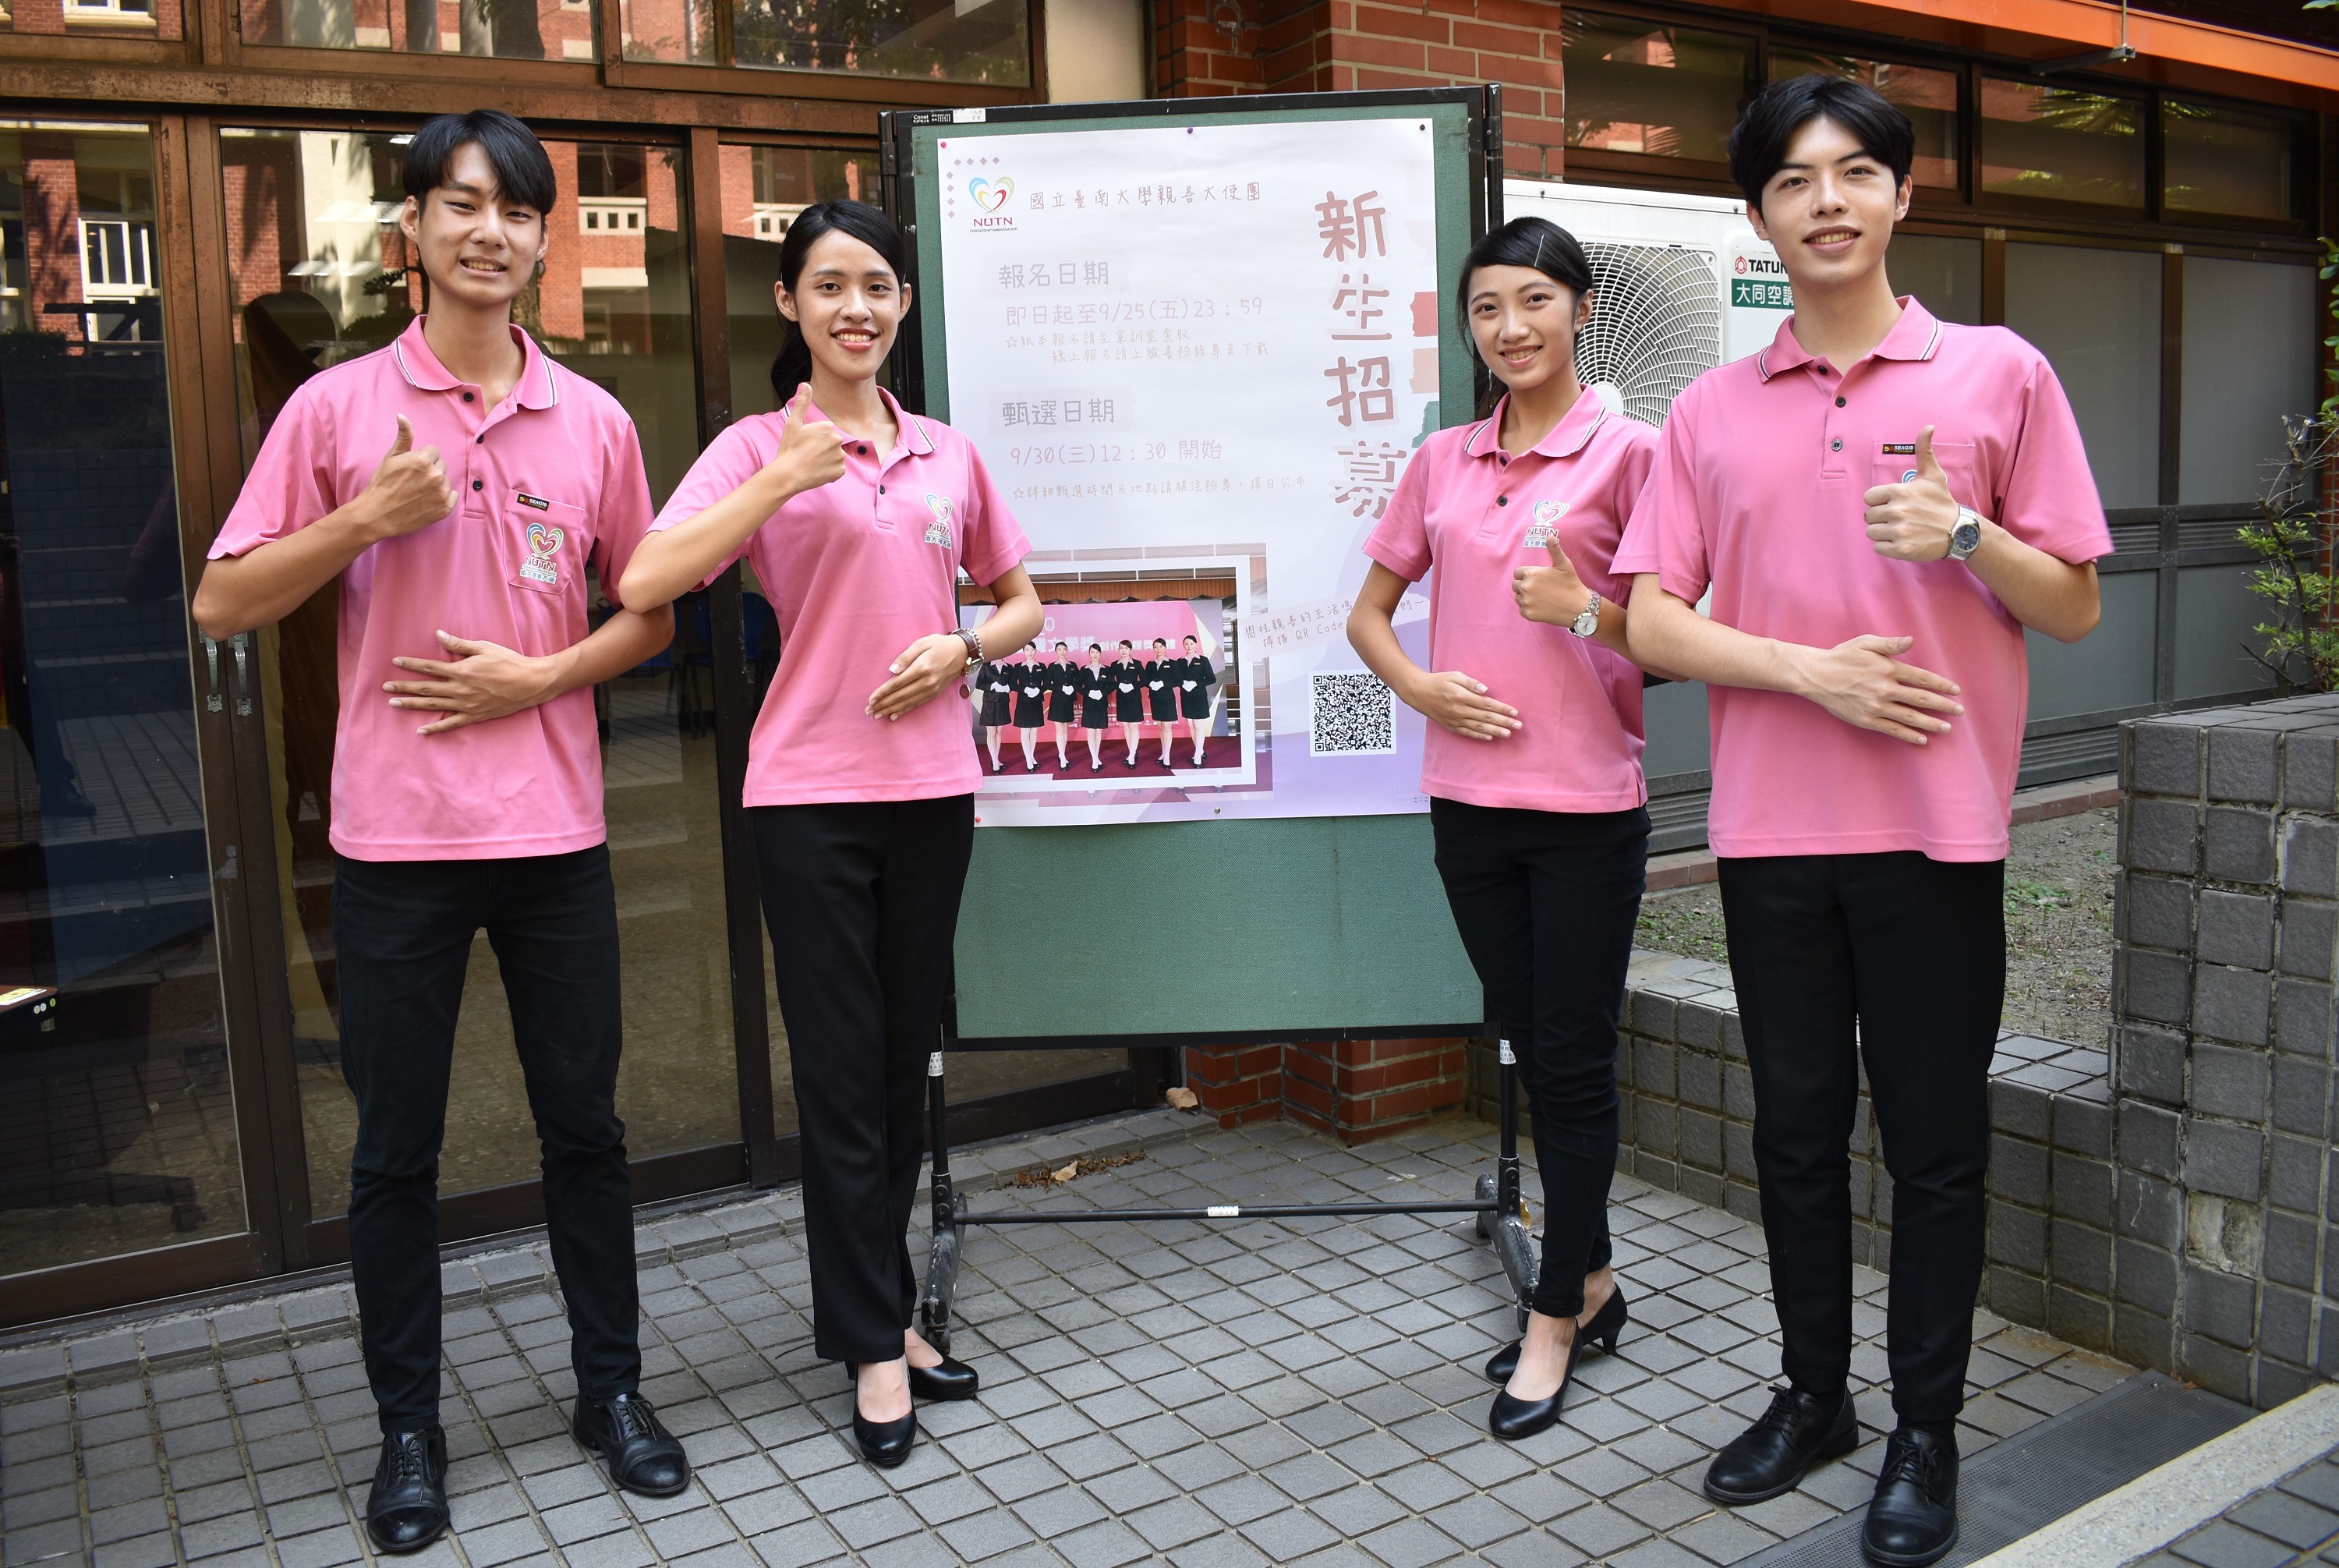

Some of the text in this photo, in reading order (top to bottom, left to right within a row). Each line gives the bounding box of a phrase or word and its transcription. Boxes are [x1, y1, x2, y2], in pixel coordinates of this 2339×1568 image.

[1029, 182, 1260, 210] 國立臺南大學親善大使團
[973, 217, 1013, 227] NUTN
[998, 260, 1109, 289] 報名日期
[1315, 189, 1407, 521] 新生招募
[1002, 398, 1115, 427] 甄選日期
[1178, 438, 1223, 461] 開始
[525, 556, 556, 571] NUTN
[1262, 620, 1343, 649] 掃描 QR Code
